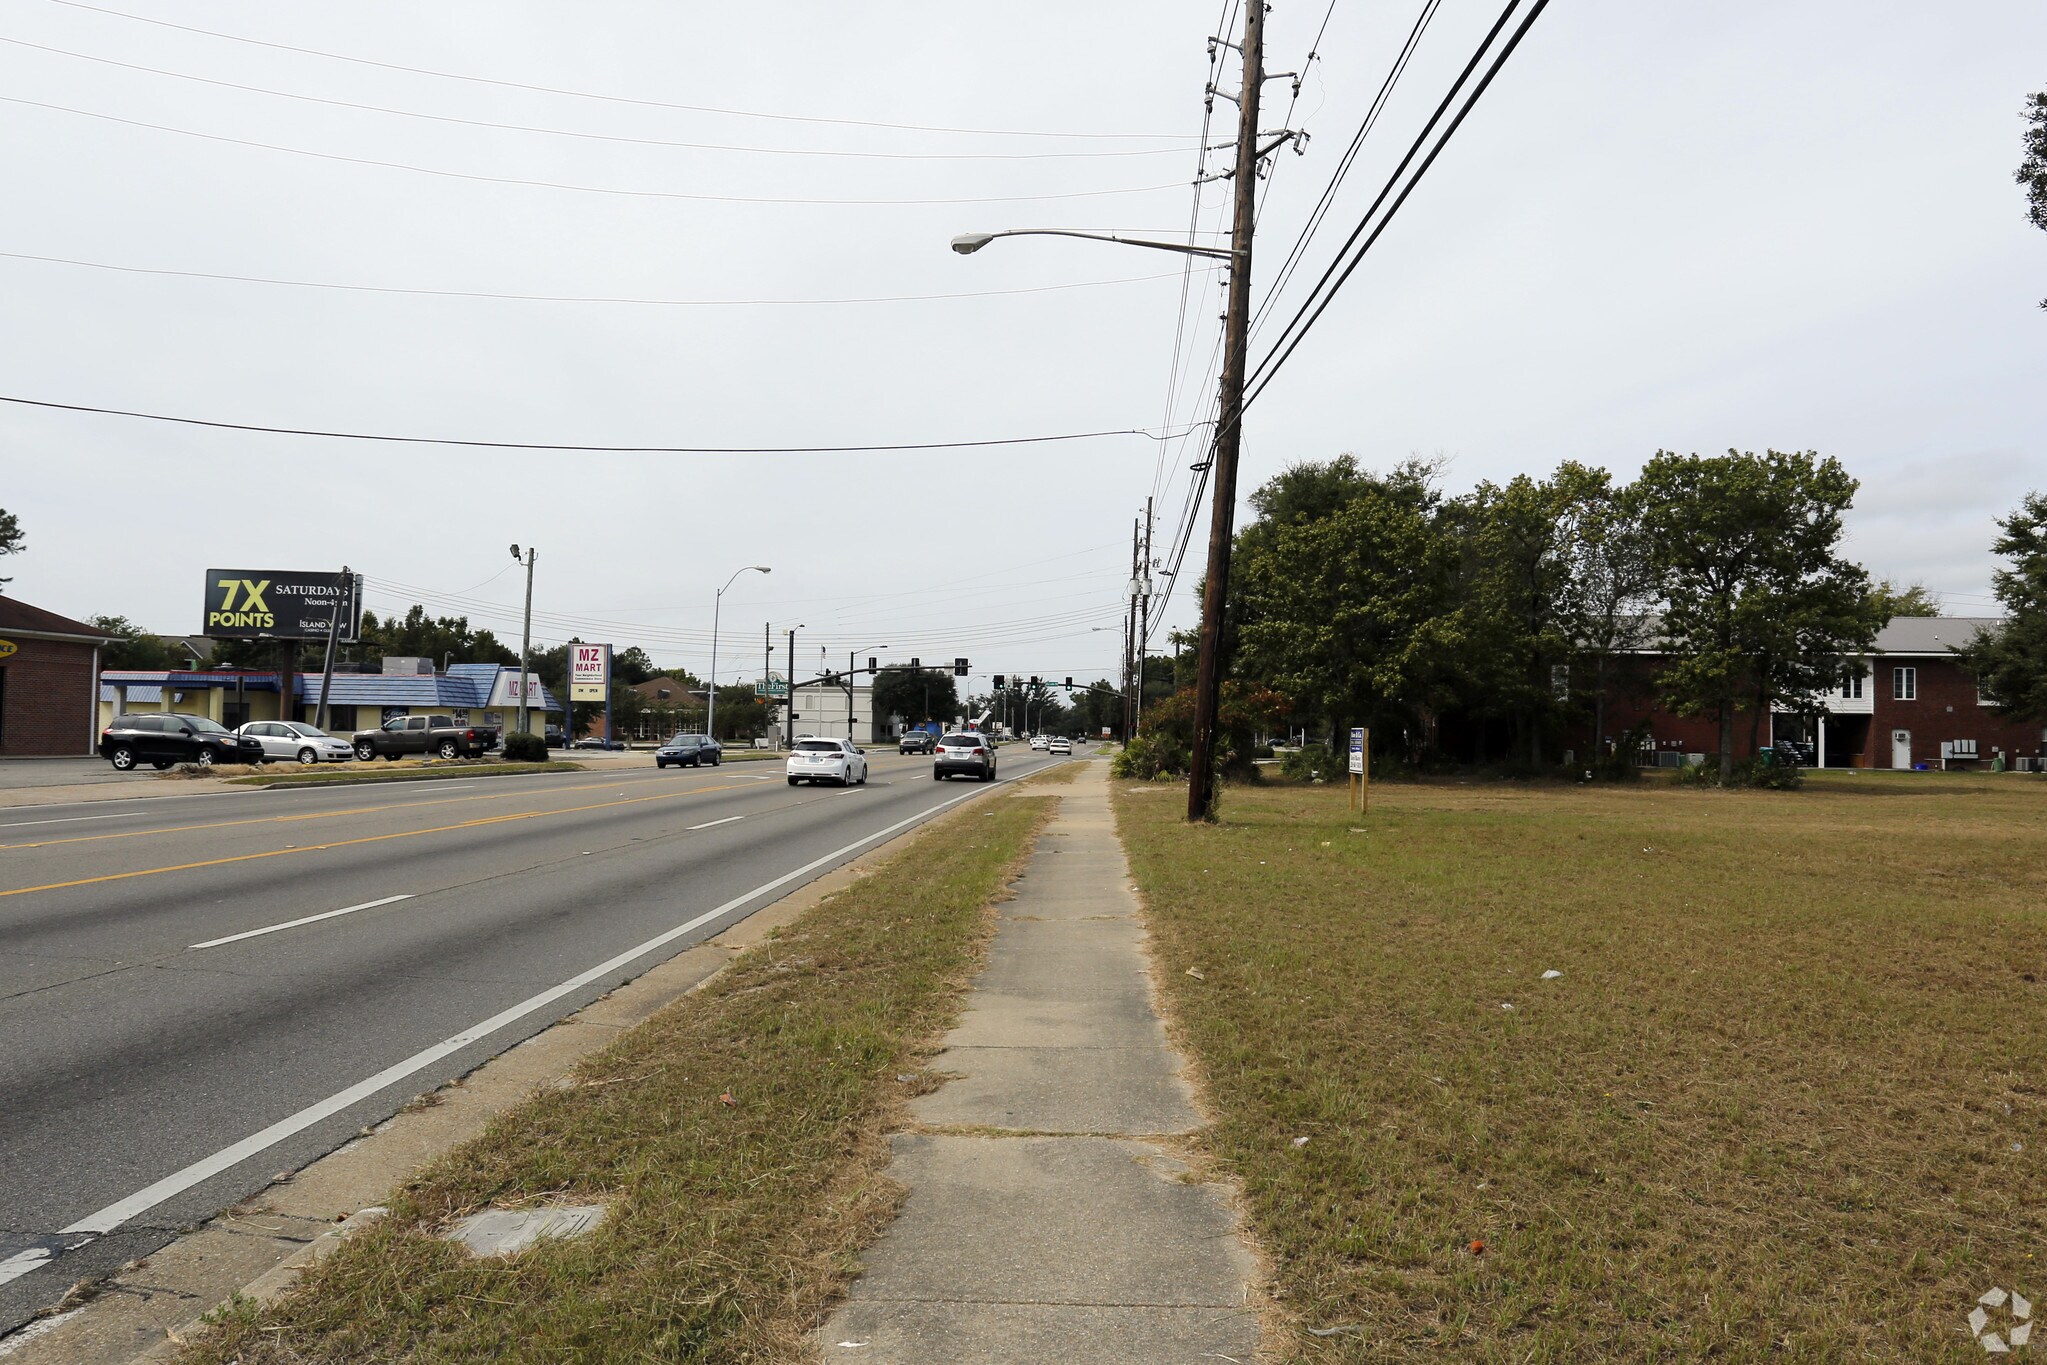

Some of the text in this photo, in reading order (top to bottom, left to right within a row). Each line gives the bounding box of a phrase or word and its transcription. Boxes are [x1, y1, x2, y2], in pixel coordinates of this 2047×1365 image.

[218, 579, 271, 613] 7X
[275, 584, 348, 596] SATURDAYS
[209, 612, 274, 628] POINTS
[299, 619, 348, 629] ISLAND VW
[579, 649, 599, 661] MZ
[509, 681, 518, 696] MZ
